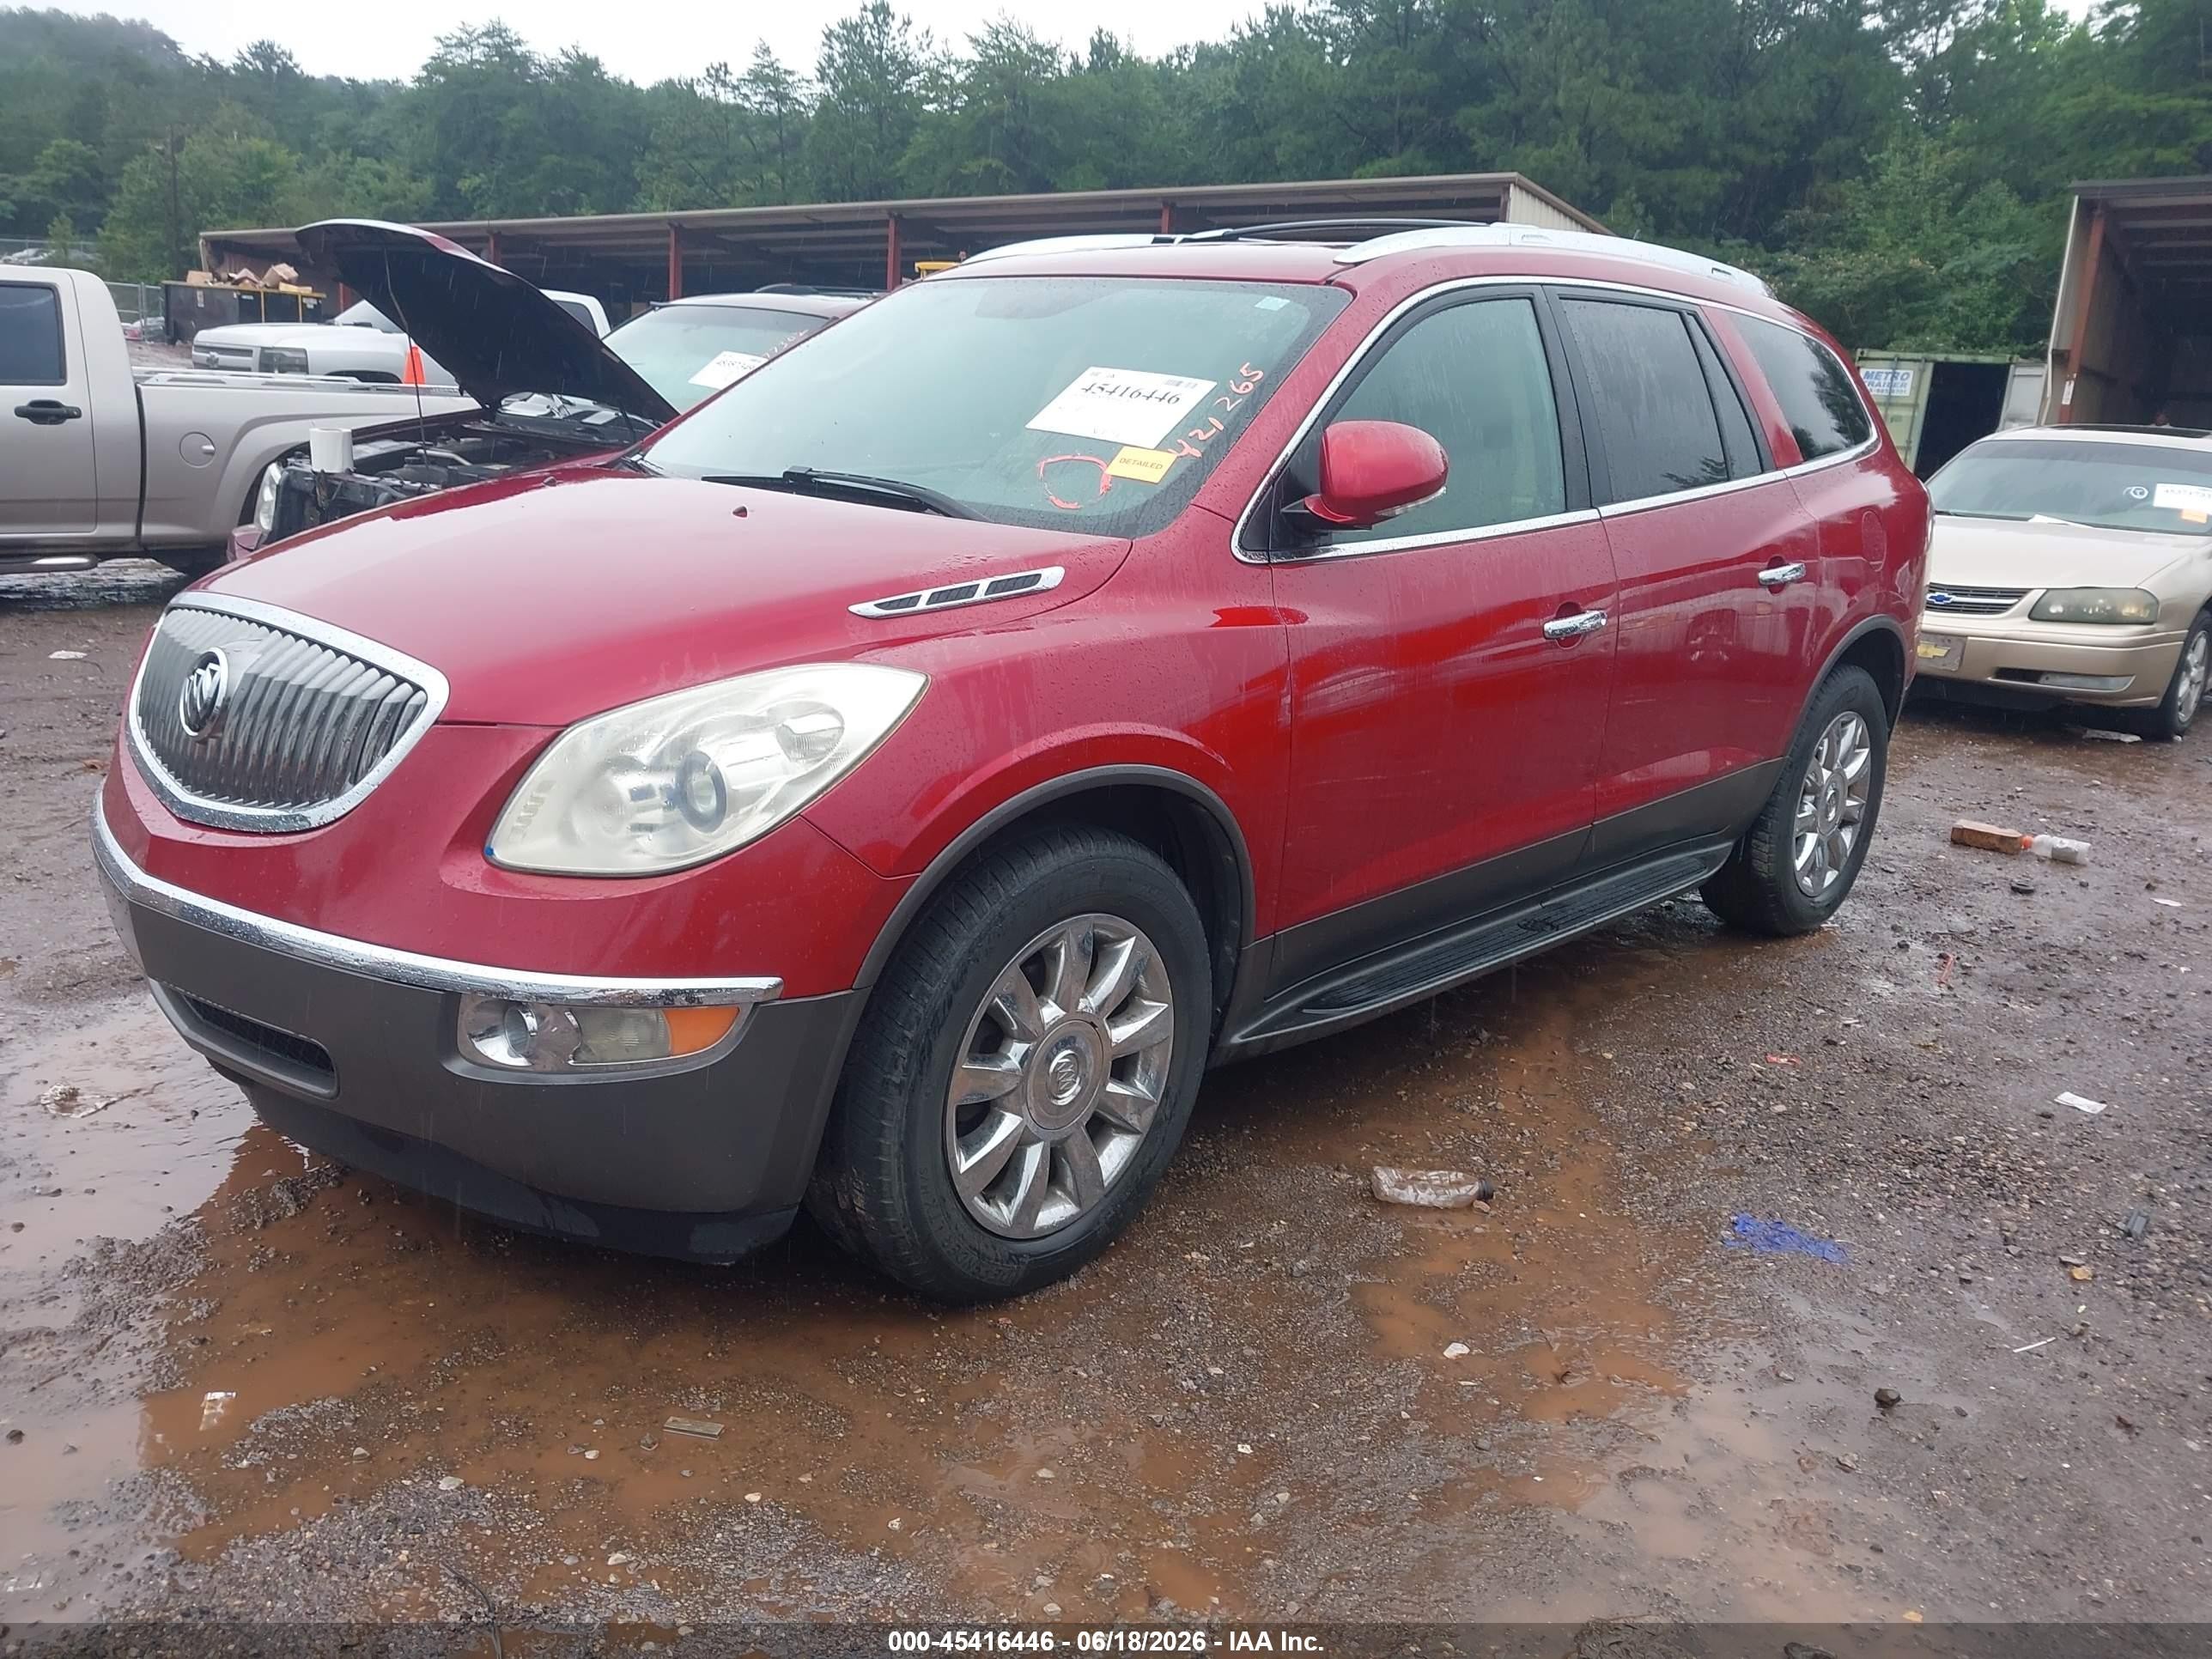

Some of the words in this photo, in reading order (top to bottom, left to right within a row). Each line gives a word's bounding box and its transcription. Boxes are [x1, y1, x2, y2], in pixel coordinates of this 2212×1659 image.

[1864, 371, 1911, 380] METRO
[1080, 382, 1182, 405] 45416446
[1118, 456, 1164, 471] DETAILED
